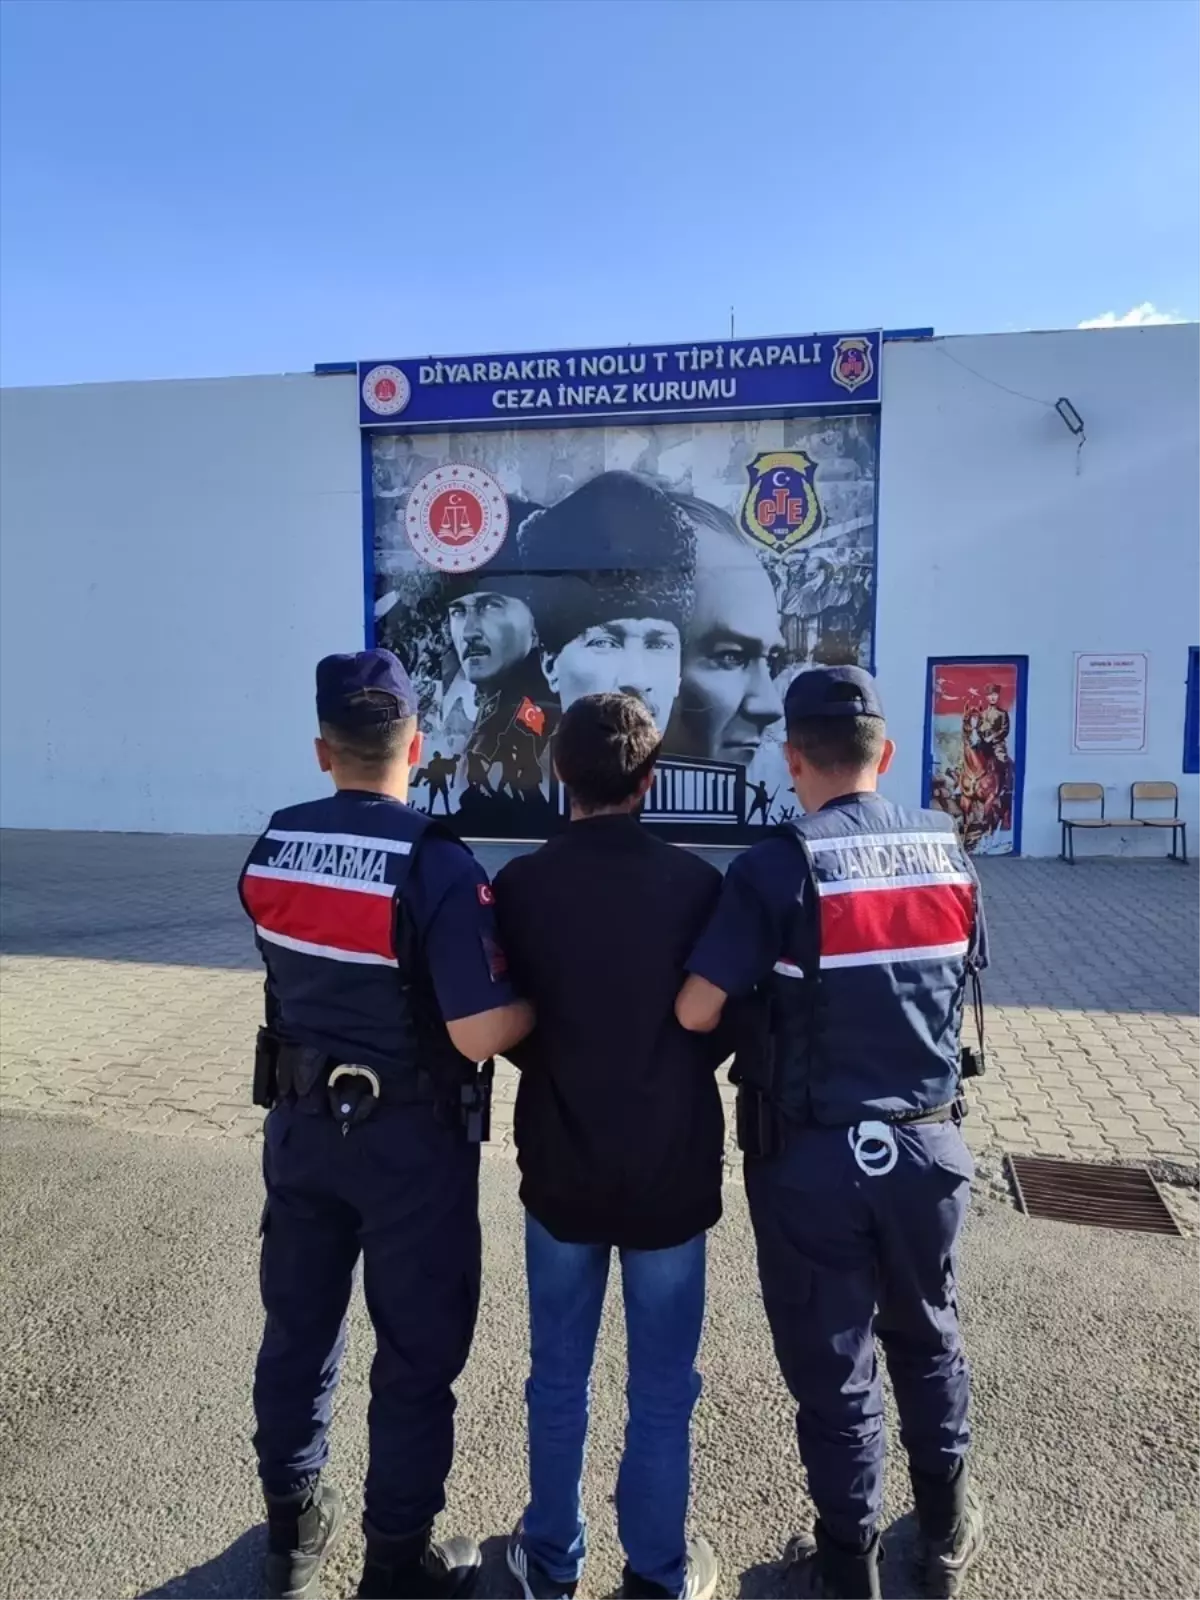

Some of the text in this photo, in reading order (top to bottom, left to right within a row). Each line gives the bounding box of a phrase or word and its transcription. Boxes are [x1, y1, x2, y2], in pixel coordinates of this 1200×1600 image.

[419, 358, 560, 384] DİYARBAKIR
[566, 357, 576, 376] 1
[580, 353, 646, 376] NOLU
[652, 351, 669, 372] T
[674, 346, 726, 371] TİPİ
[729, 342, 822, 368] KAPALI
[491, 377, 737, 409] CEZA İNFAZ KURUMU
[758, 488, 803, 526] CTE
[268, 841, 388, 883] JANDARMA
[832, 843, 956, 881] JANDARMA
